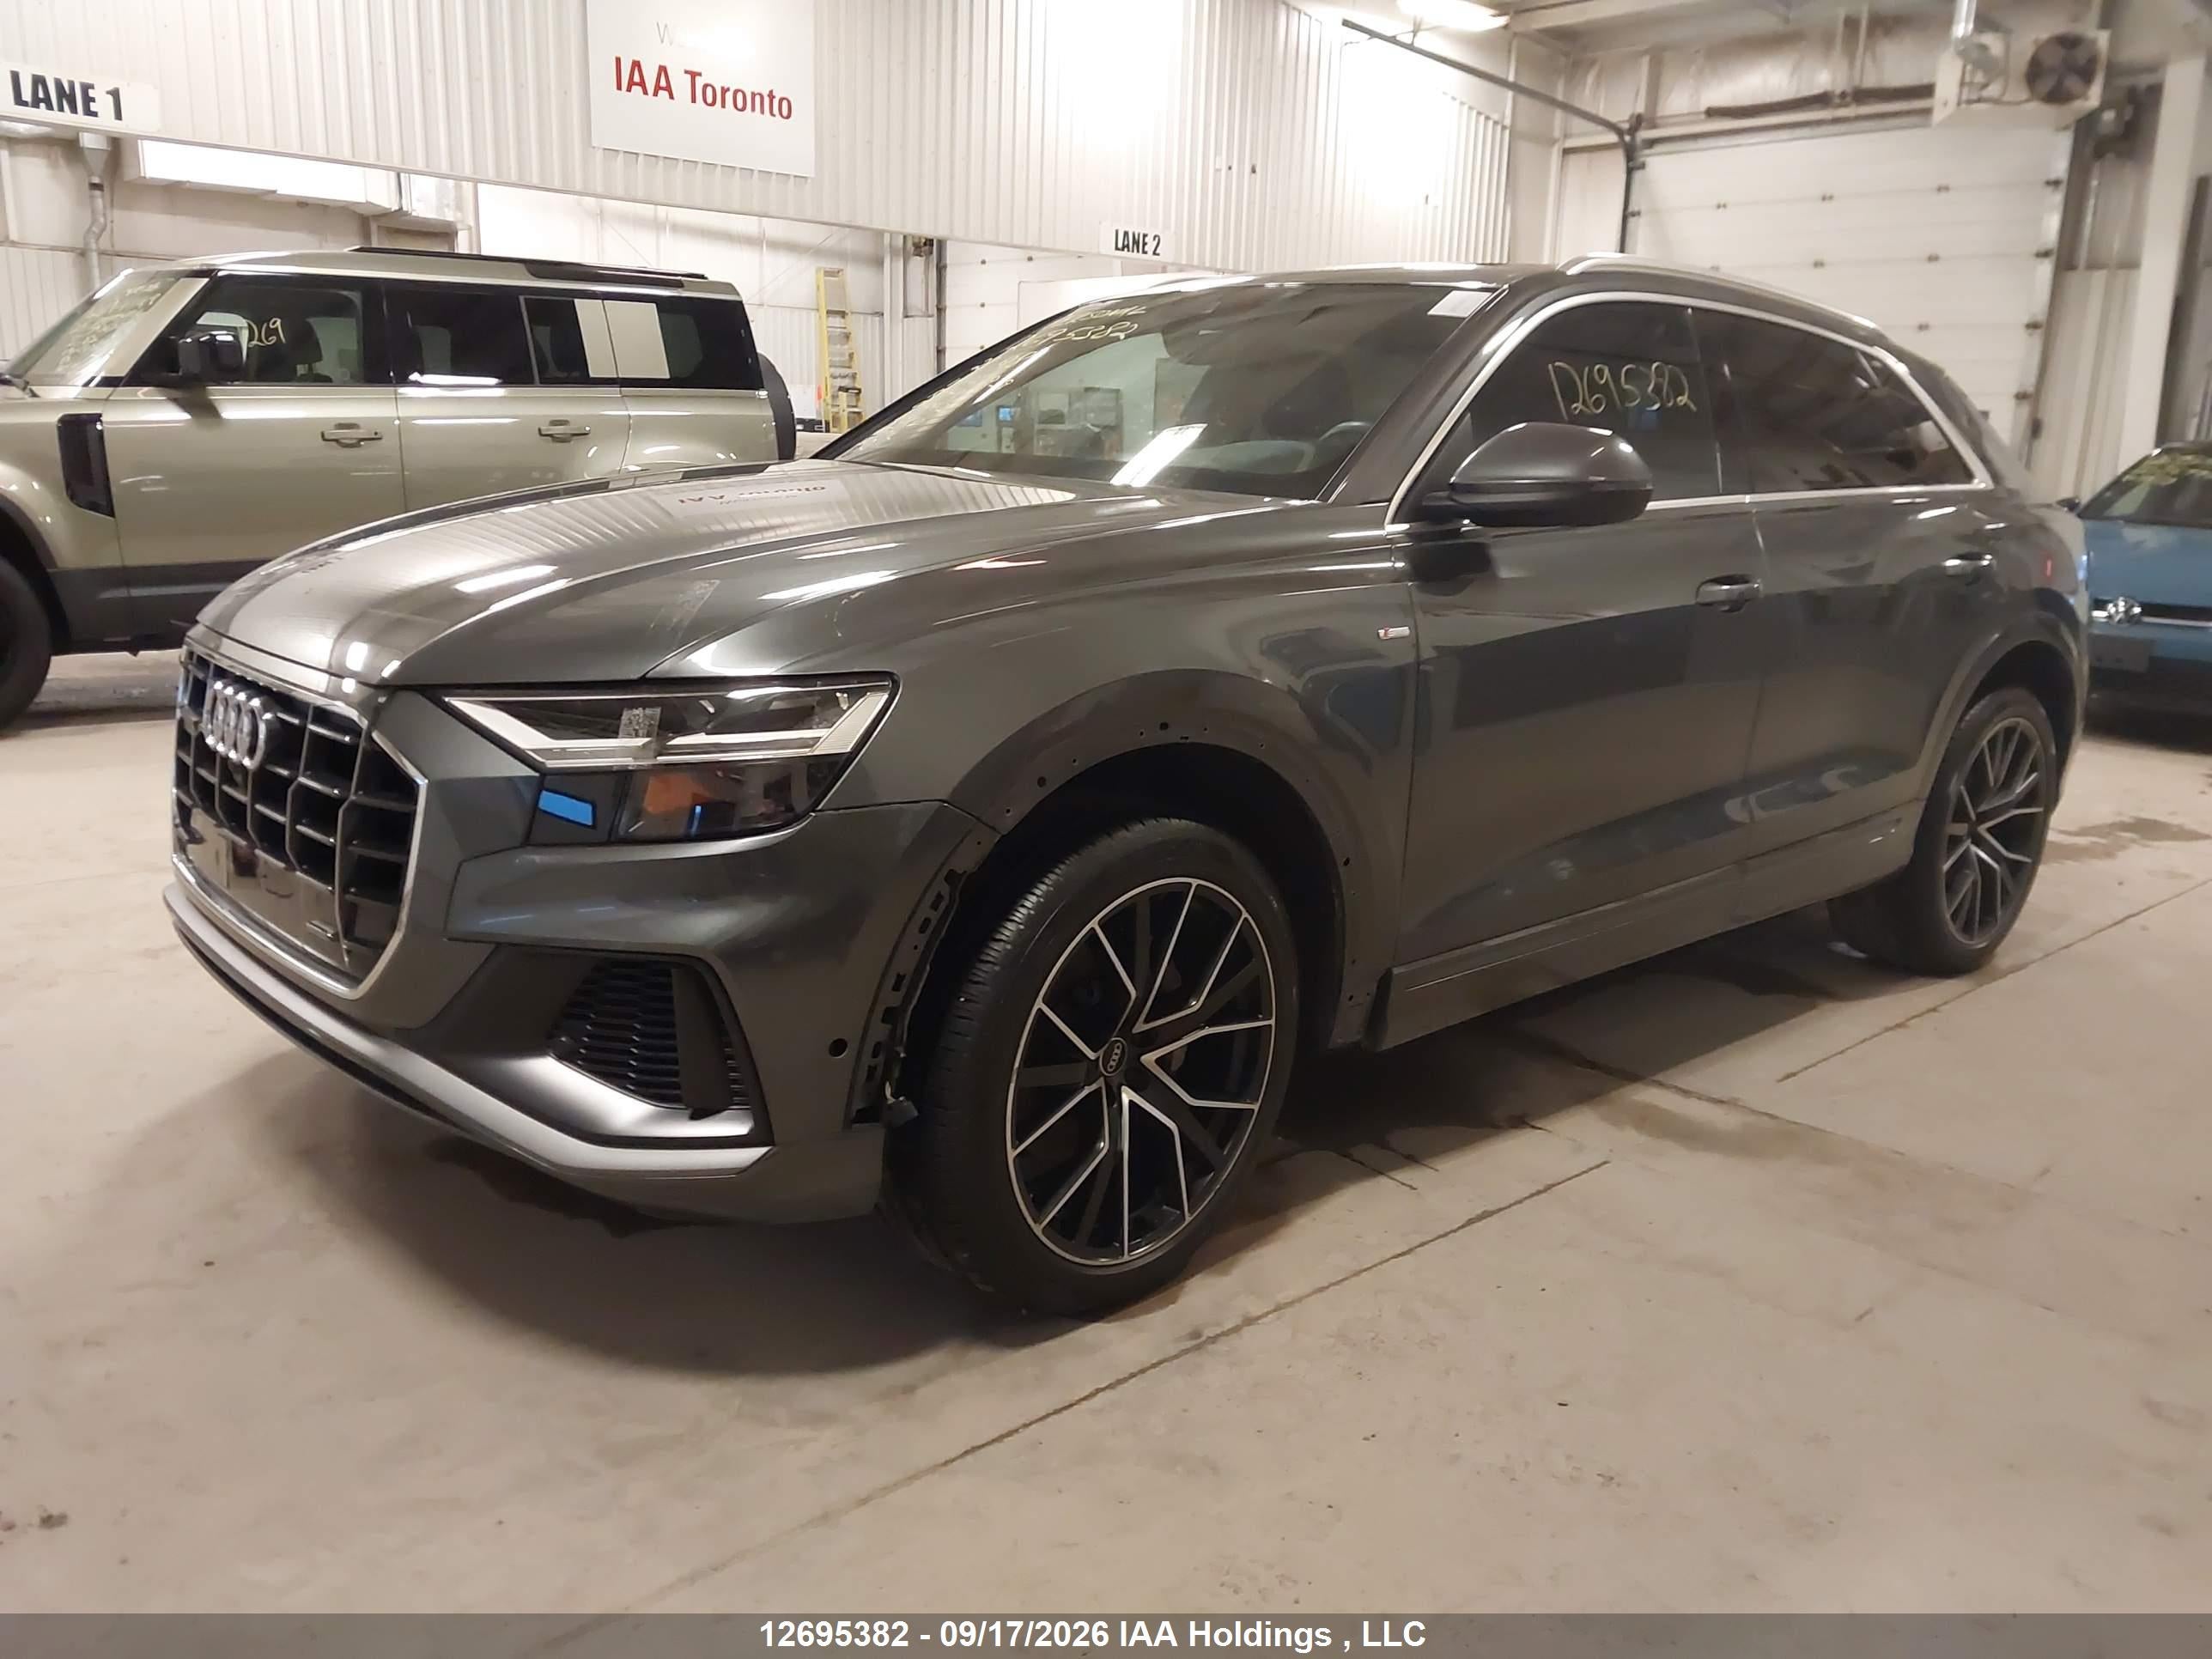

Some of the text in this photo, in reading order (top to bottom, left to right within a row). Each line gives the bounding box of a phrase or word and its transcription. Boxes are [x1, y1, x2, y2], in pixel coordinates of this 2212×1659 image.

[9, 70, 123, 121] LANE 1
[615, 56, 793, 119] IAA Toronto
[1115, 228, 1161, 256] LANE 2
[1547, 361, 1697, 422] 12695382
